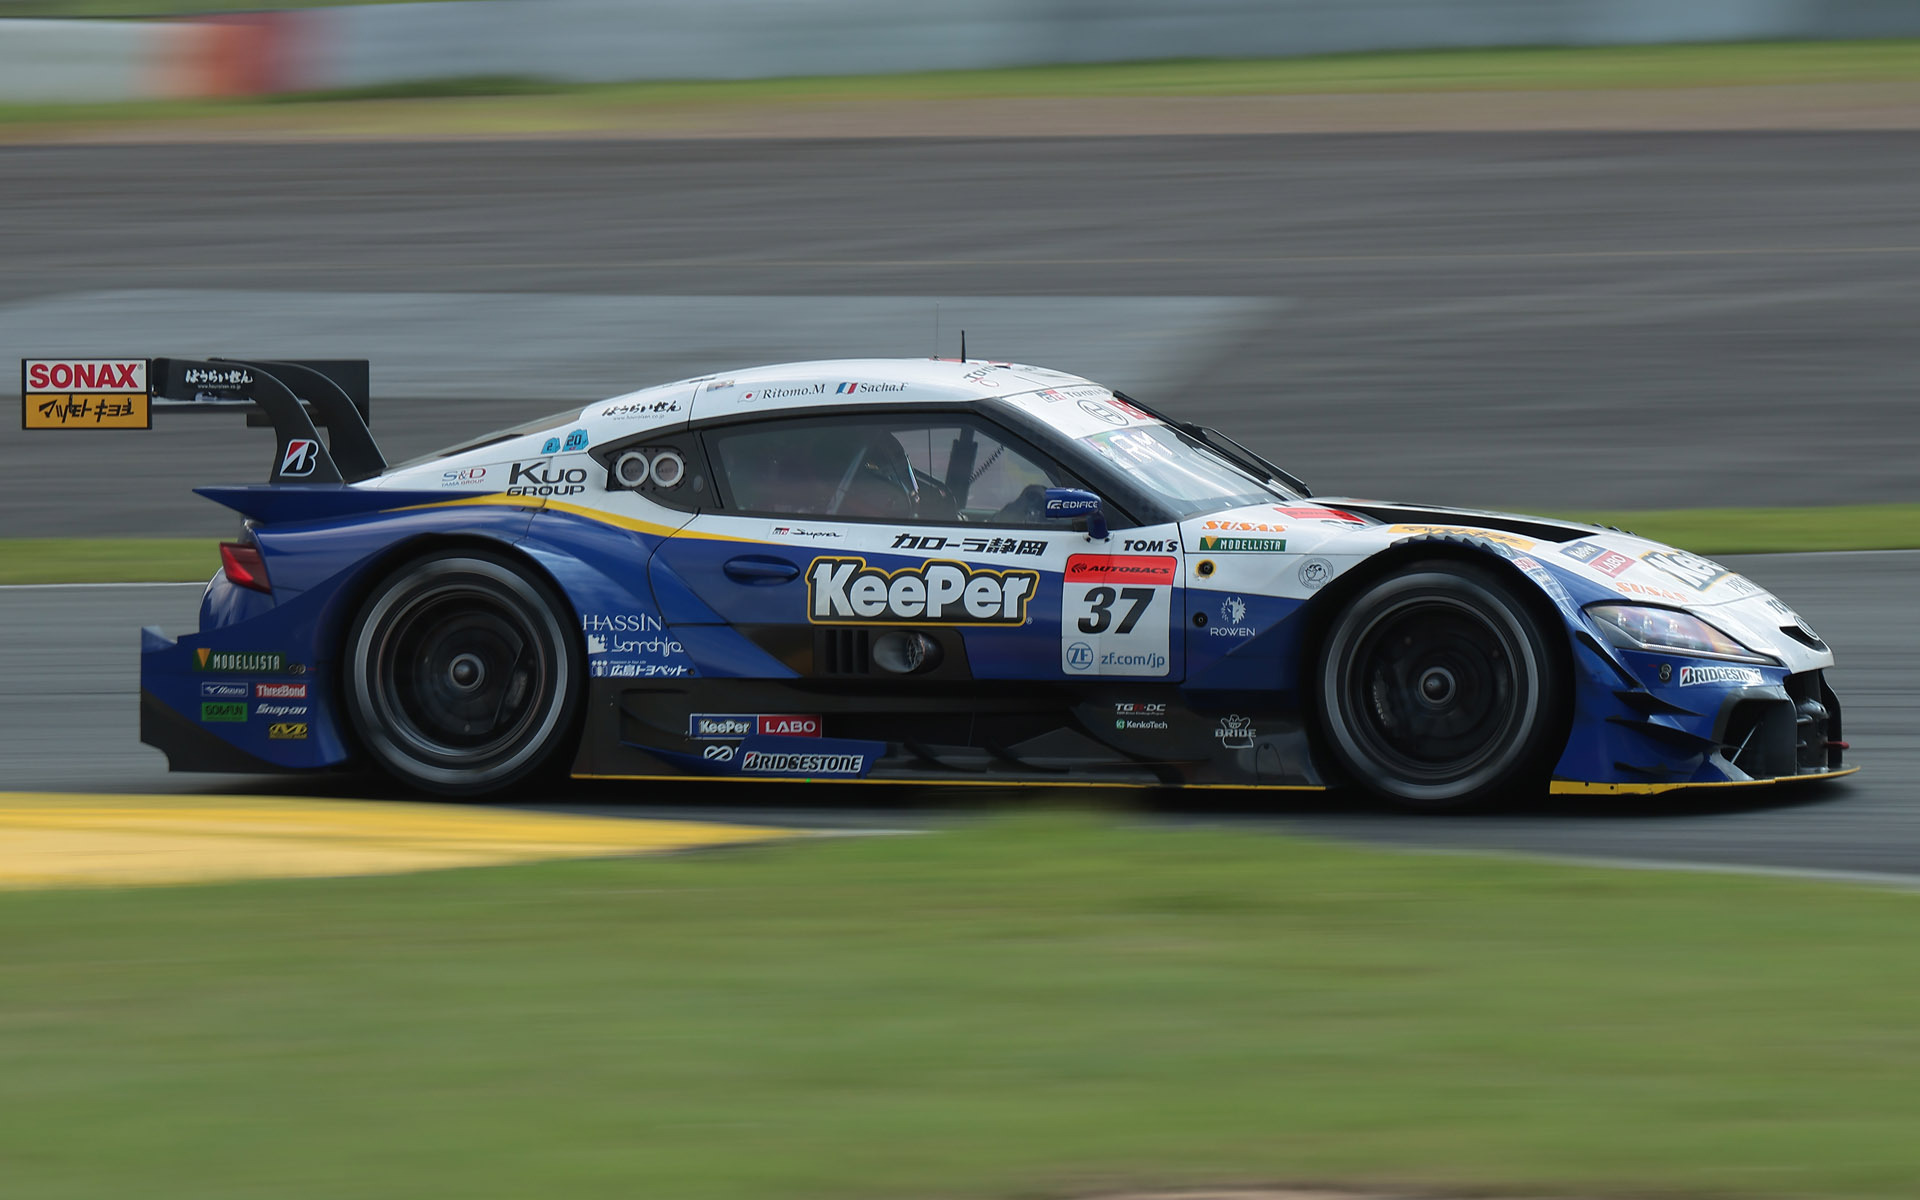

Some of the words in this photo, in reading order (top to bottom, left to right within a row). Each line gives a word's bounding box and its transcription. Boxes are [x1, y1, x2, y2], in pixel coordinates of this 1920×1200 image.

[29, 363, 139, 389] SONAX
[763, 384, 826, 399] Ritomo.M
[860, 382, 909, 393] Sacha.F
[566, 434, 583, 446] 20
[441, 467, 487, 481] S&D
[460, 478, 484, 486] GROUP
[506, 485, 586, 497] GROUP
[1062, 501, 1098, 509] EDIFICE
[1202, 520, 1289, 532] SUSAS
[791, 529, 844, 540] Supra
[890, 533, 1049, 557] カローラ静岡
[1124, 540, 1178, 552] TOM'S
[1220, 540, 1281, 551] MODELLISTA
[1088, 566, 1171, 574] AUTOBACS
[810, 560, 1034, 620] KeePer
[1077, 586, 1156, 635] 37
[582, 612, 663, 631] HASSIN
[1210, 627, 1256, 637] ROWEN
[213, 654, 281, 671] MODELLISTA
[1068, 647, 1093, 665] ZF
[1101, 652, 1166, 668] zf.com/jp
[610, 664, 688, 677] 広島トヨペット
[257, 684, 306, 698] ThreeBond
[256, 703, 308, 717] Snap-on
[698, 720, 751, 735] KeePer
[765, 720, 817, 734] LABO
[1126, 720, 1168, 729] KenkoTech
[1215, 729, 1257, 738] BRIDE
[742, 752, 864, 773] BRIDGESTONE
